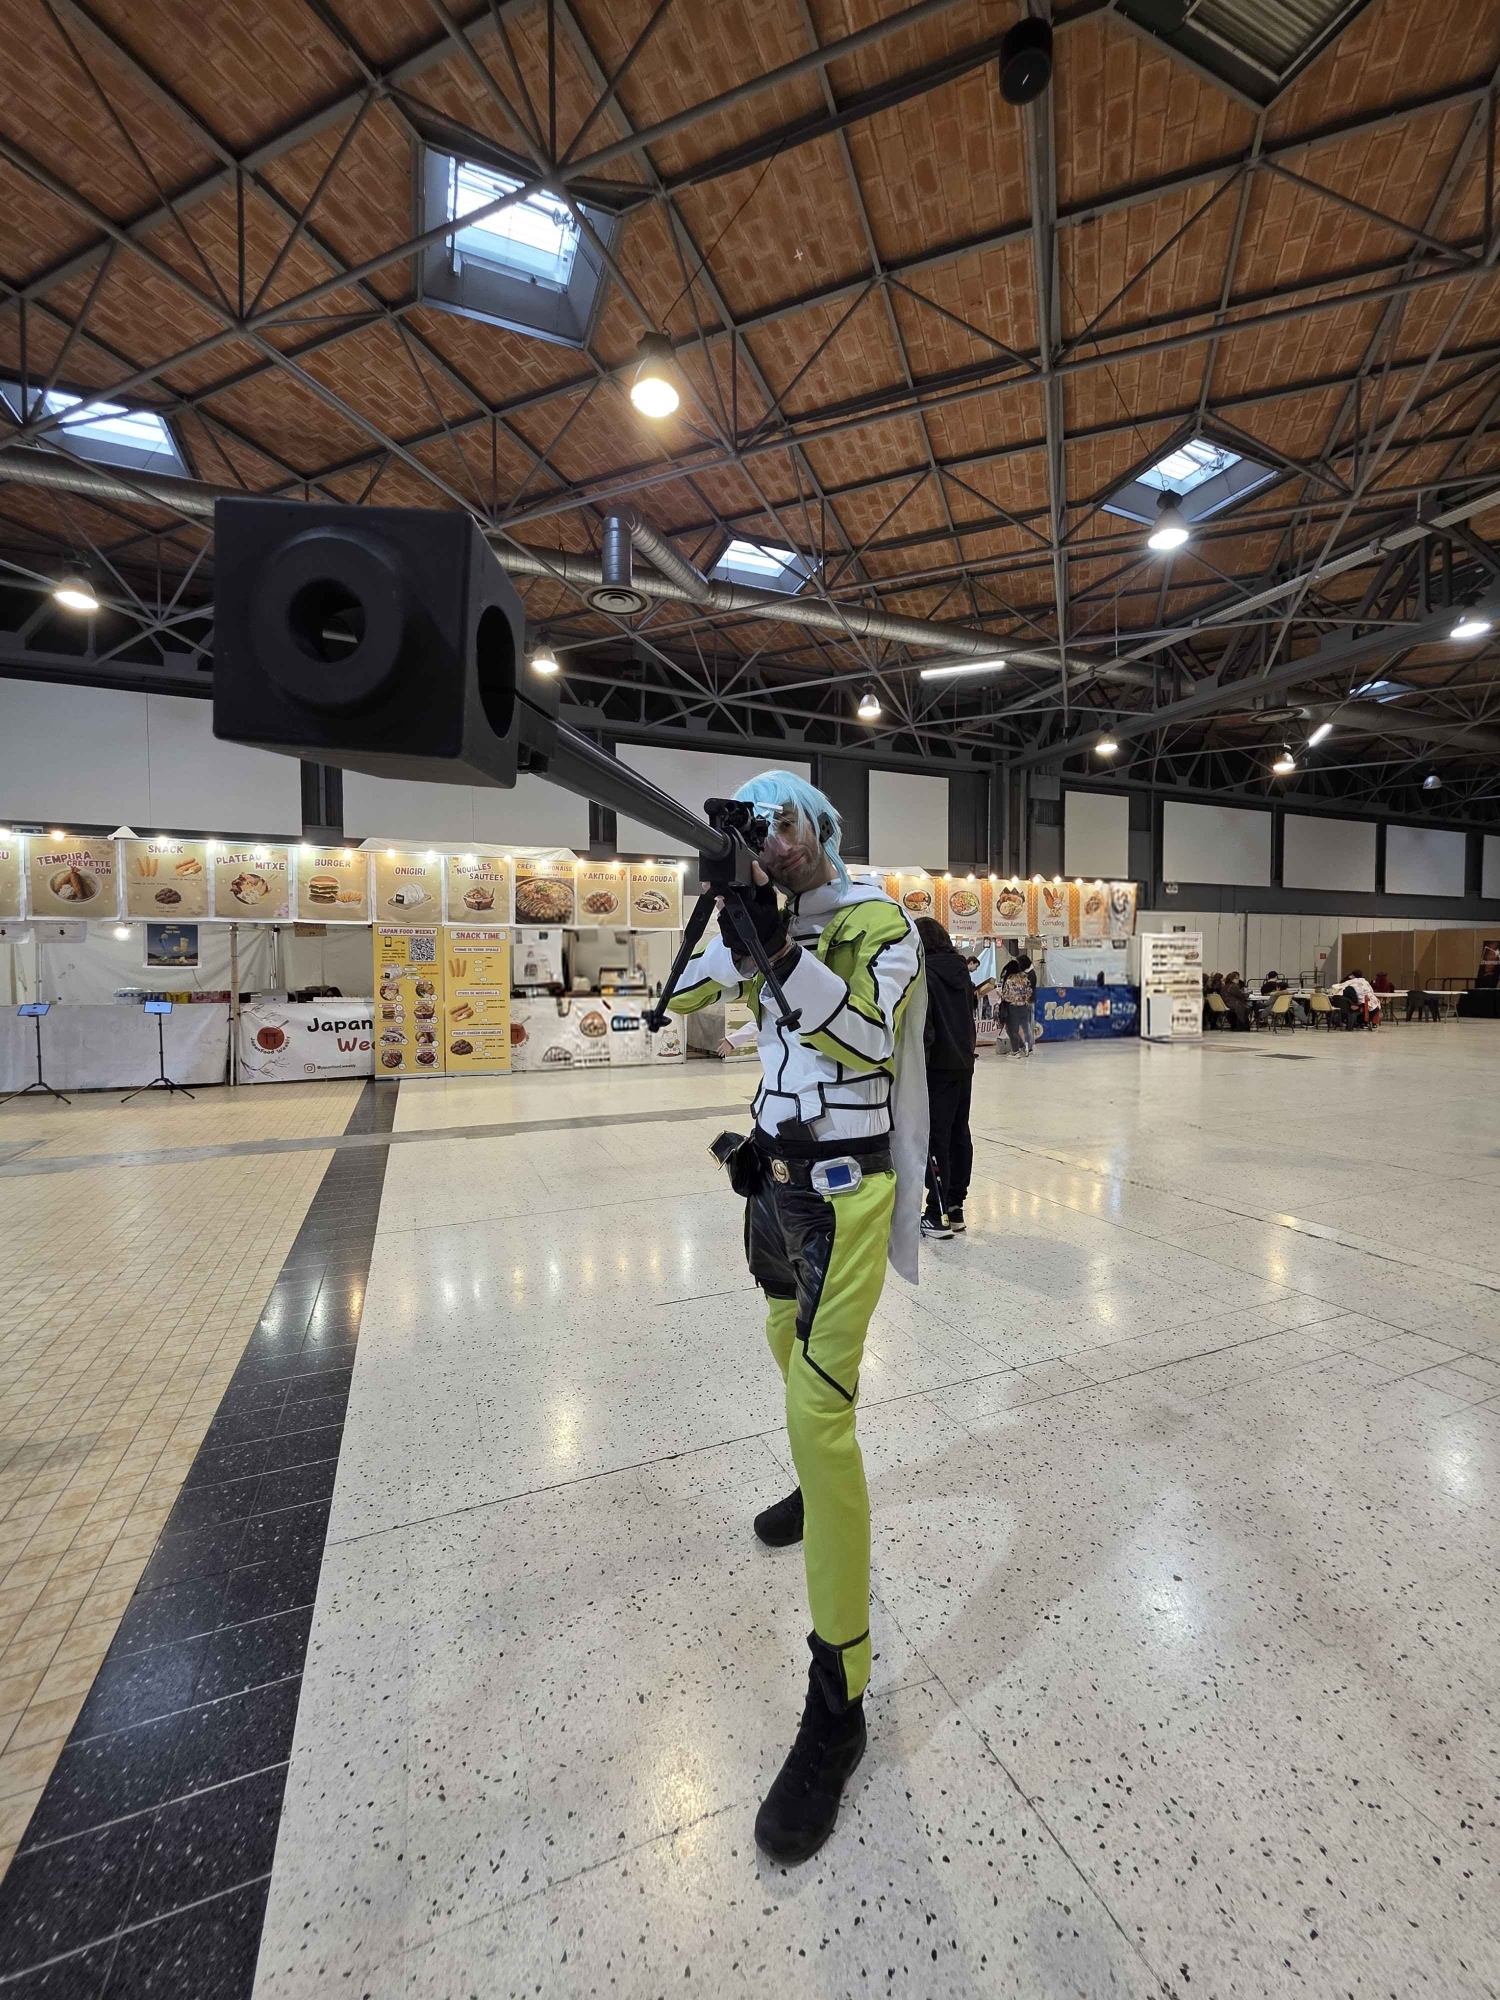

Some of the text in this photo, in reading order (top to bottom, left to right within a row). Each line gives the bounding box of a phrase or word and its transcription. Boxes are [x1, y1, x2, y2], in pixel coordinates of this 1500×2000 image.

[148, 845, 184, 854] SNACK
[36, 851, 92, 866] TEMPURA
[67, 859, 111, 868] CREVETTE
[216, 853, 262, 865] PLATEAU
[314, 858, 351, 868] BURGER
[395, 867, 426, 876] ONIGIRI
[456, 863, 492, 875] NOUILLES
[469, 871, 504, 881] SAUTÉES
[583, 873, 617, 881] YAKITORI
[632, 874, 648, 882] BAO
[306, 1017, 373, 1034] Japan
